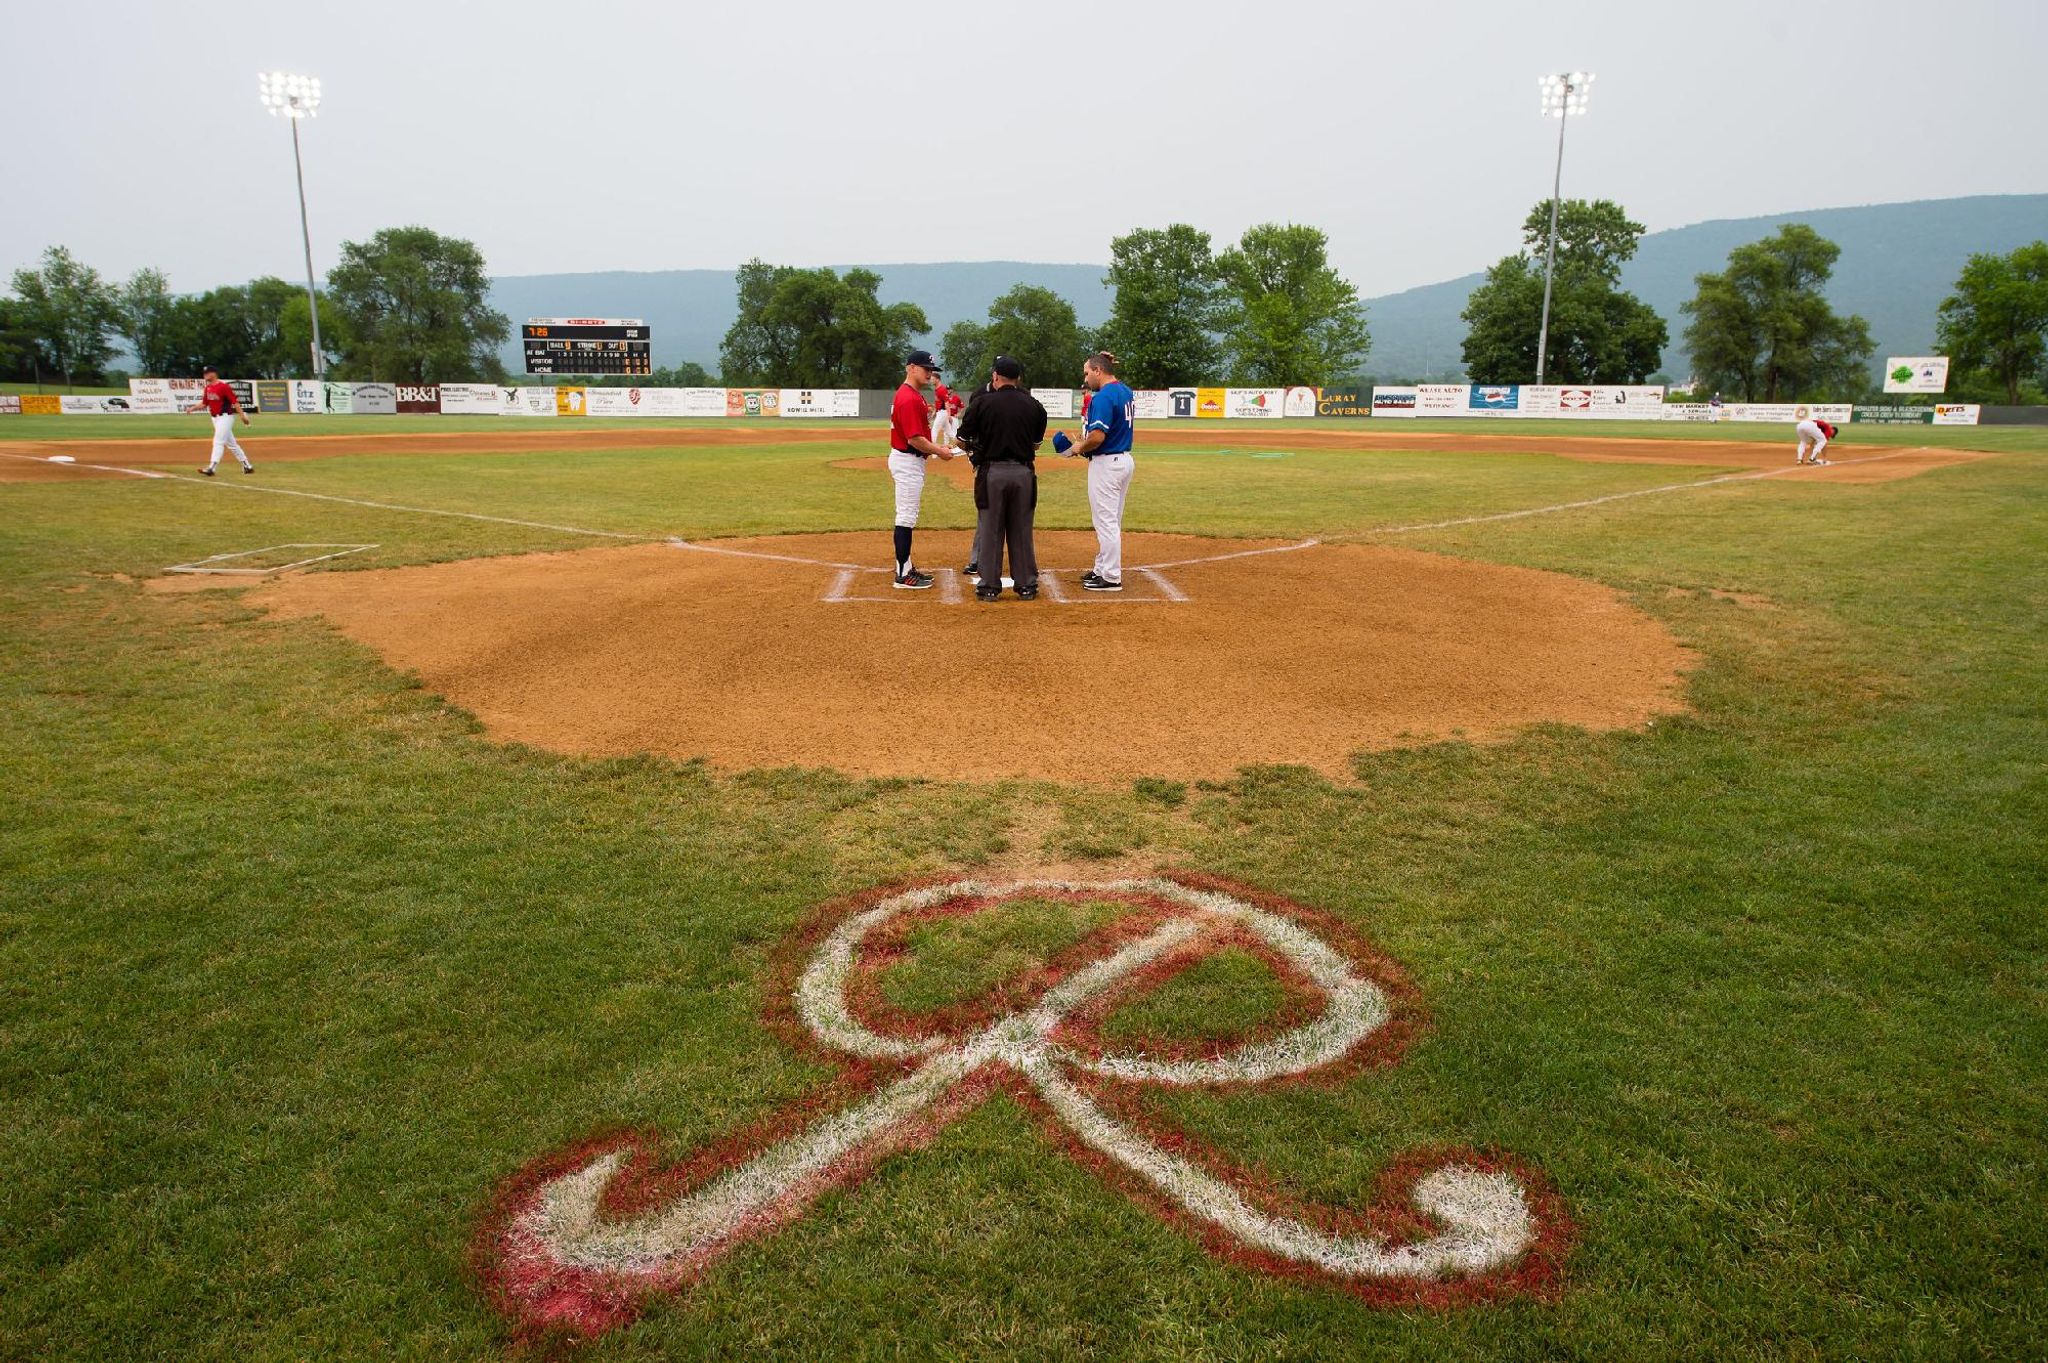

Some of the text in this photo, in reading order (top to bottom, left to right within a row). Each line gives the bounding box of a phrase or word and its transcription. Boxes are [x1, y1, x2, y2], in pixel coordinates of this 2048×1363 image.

[395, 386, 439, 403] BB&T
[1317, 387, 1356, 402] LURAY
[1318, 402, 1370, 415] CAVERNS
